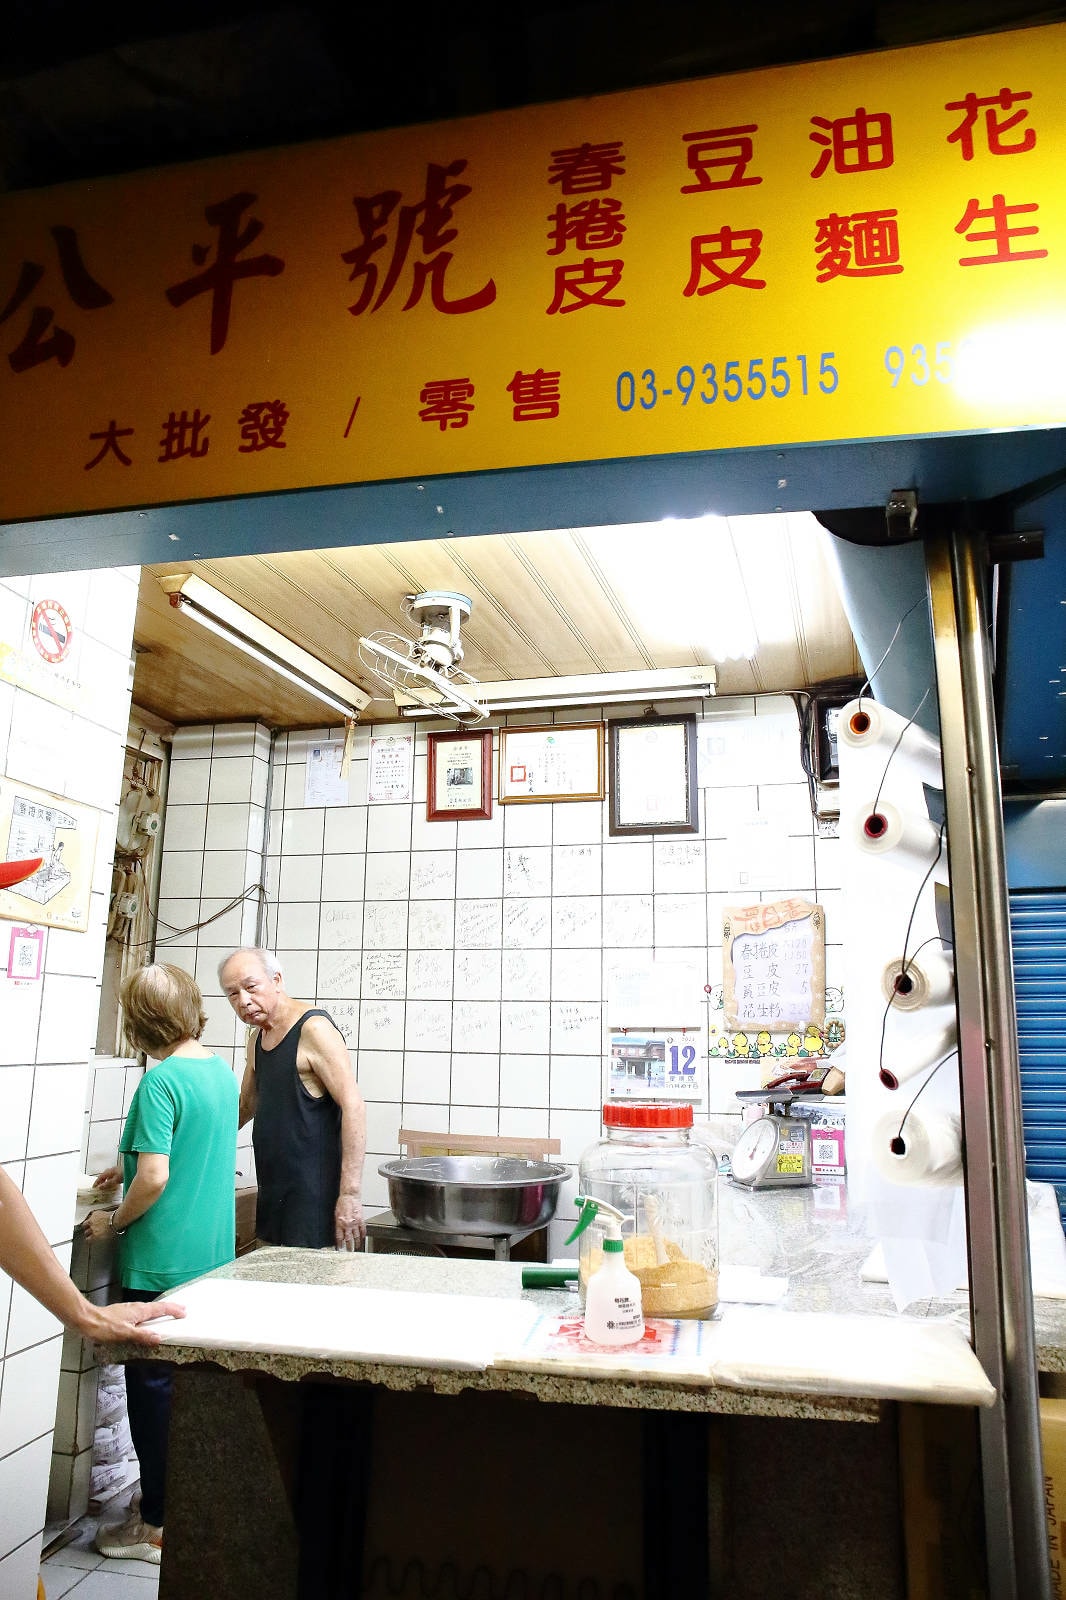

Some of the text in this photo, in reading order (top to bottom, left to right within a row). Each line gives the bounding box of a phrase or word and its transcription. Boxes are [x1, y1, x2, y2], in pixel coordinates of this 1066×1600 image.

[546, 141, 627, 316] 春捲皮
[680, 123, 767, 297] 豆皮
[809, 106, 905, 284] 油麵
[944, 87, 1049, 267] 花生
[0, 158, 497, 374] 公平號
[84, 399, 289, 471] 大批發
[418, 368, 562, 431] 零售
[615, 351, 840, 414] 03-9355515
[668, 1045, 697, 1075] 12
